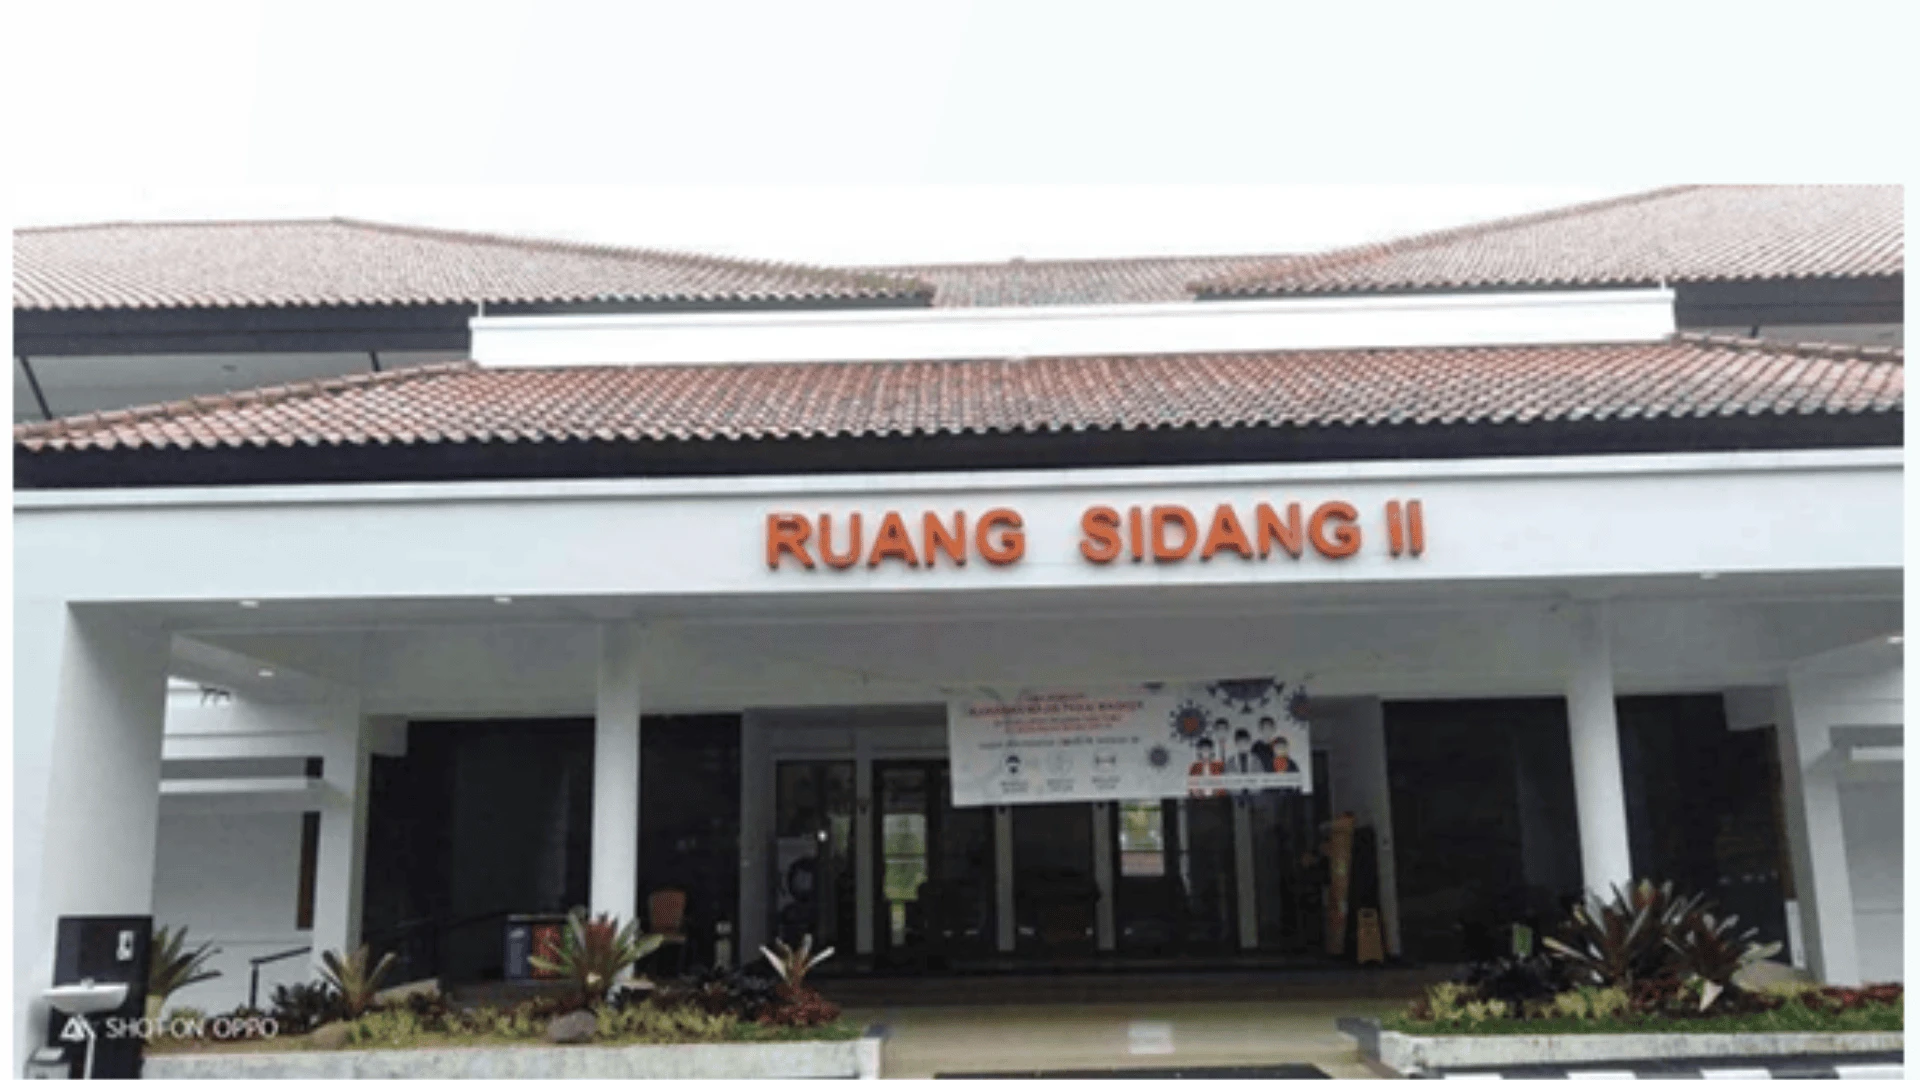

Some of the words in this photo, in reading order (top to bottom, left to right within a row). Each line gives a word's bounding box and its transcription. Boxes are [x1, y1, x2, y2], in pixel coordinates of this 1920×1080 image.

[766, 510, 1026, 569] RUANG
[1079, 502, 1362, 563] SIDANG
[1386, 500, 1425, 557] II
